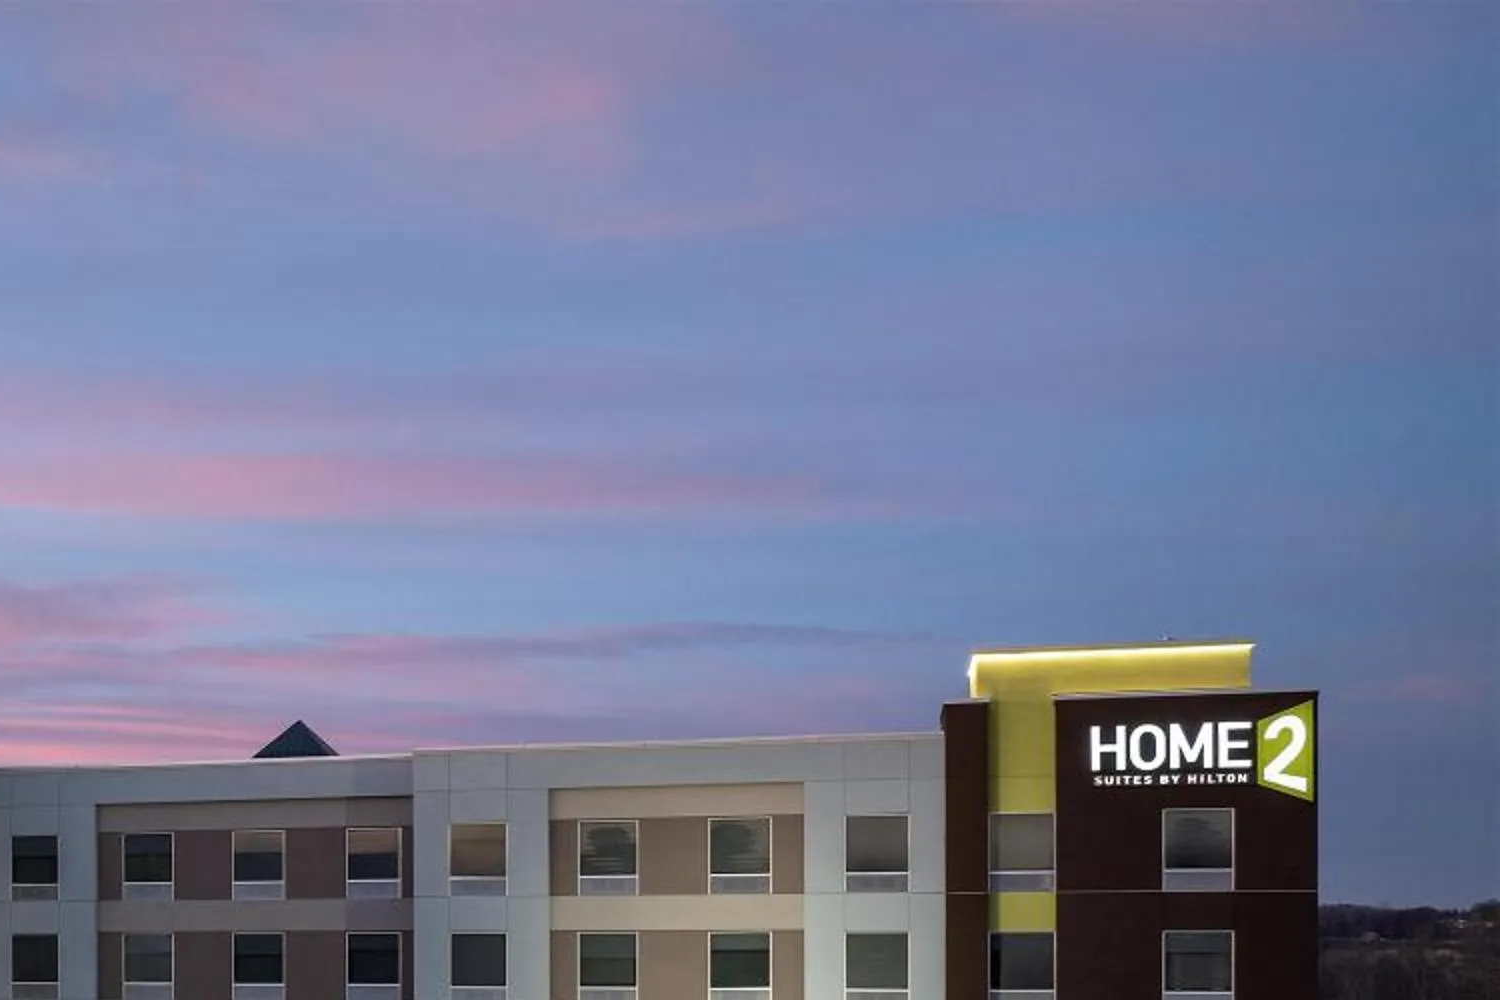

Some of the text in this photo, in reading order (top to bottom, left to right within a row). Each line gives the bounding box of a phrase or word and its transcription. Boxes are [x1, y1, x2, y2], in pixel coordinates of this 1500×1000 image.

[1089, 715, 1308, 792] HOME 2
[1093, 773, 1249, 786] SUITES BY HILTON
